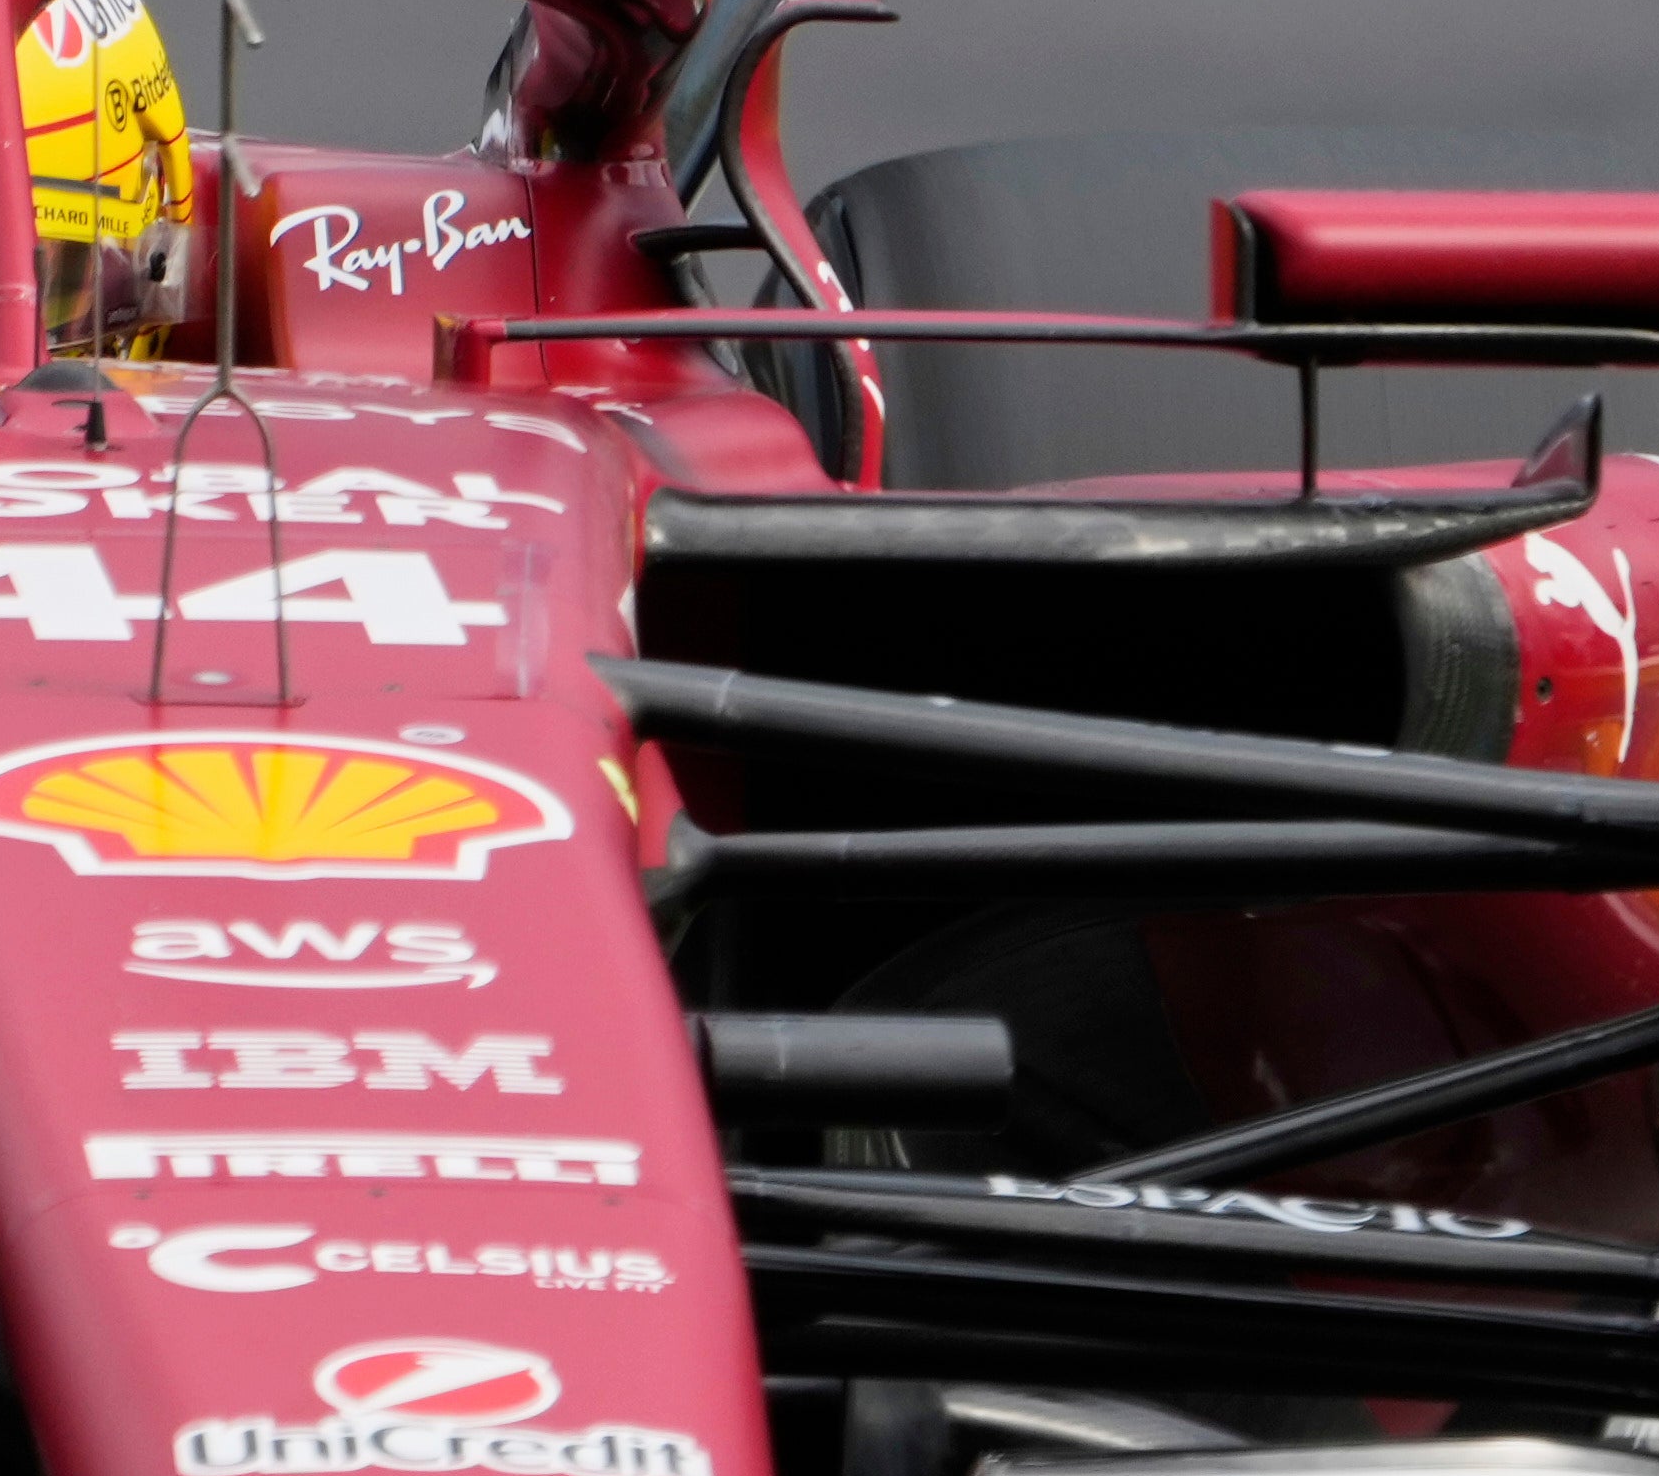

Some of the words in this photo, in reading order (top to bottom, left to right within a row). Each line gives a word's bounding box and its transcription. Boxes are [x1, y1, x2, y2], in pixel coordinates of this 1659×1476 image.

[34, 205, 89, 226] CHARD
[130, 920, 476, 963] aws
[111, 1030, 565, 1095] IBM
[83, 1134, 641, 1186] PIRELLI
[314, 1242, 668, 1284] CELSIUS
